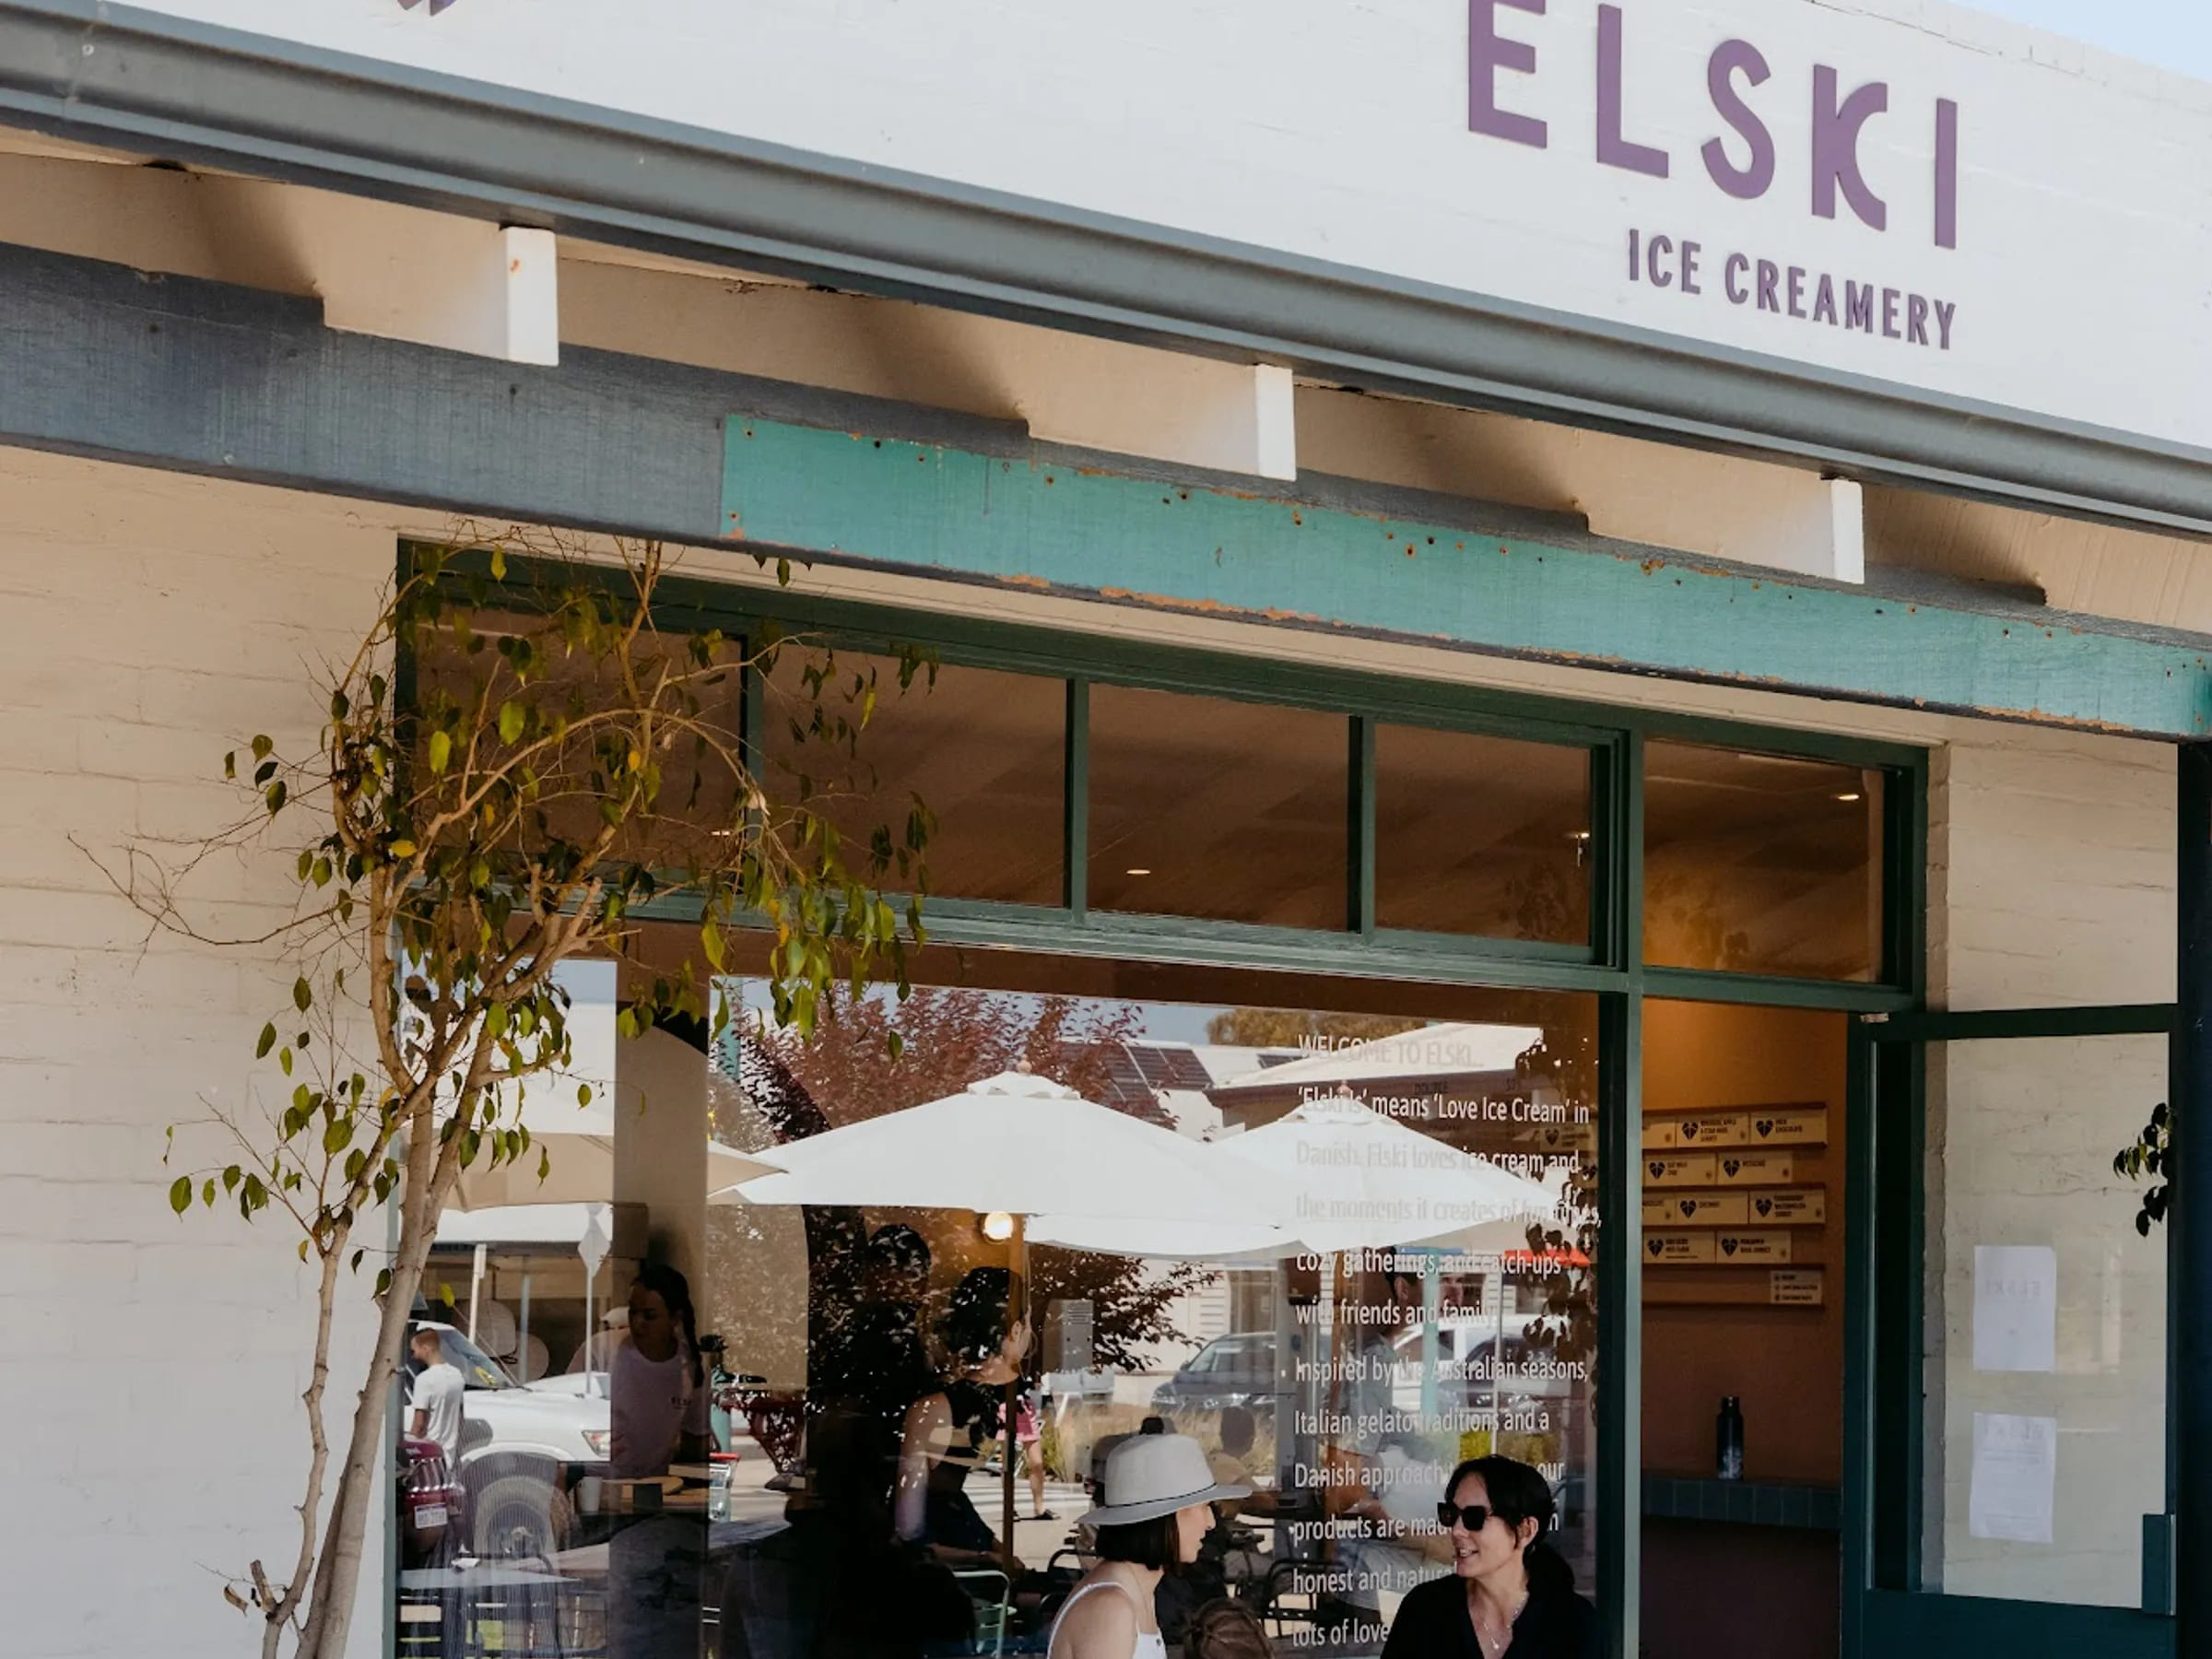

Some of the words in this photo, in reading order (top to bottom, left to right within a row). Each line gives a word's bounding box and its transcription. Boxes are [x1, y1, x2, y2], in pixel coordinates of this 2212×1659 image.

[1468, 0, 1958, 250] ELSKI
[1630, 228, 1701, 295] ICE
[1724, 252, 1956, 350] CREAMERY
[1297, 1032, 1391, 1064] WELCOME
[1398, 1041, 1421, 1065] TO
[1372, 1095, 1430, 1118] means
[1482, 1096, 1508, 1122] Ice
[1574, 1100, 1589, 1124] in
[1412, 1145, 1457, 1171] loves
[1492, 1152, 1545, 1174] cream
[1549, 1150, 1579, 1174] and
[1295, 1194, 1324, 1219] the
[1330, 1199, 1414, 1221] moments
[1433, 1199, 1500, 1222] creates
[1296, 1251, 1338, 1277] cozy
[1340, 1298, 1401, 1325] friends
[1406, 1299, 1437, 1325] and
[1295, 1355, 1367, 1387] Inspired
[1373, 1355, 1394, 1387] by
[1431, 1355, 1516, 1381] Australian
[1294, 1410, 1352, 1434] Italian
[1358, 1409, 1413, 1439] gelato
[1418, 1406, 1499, 1433] traditions
[1504, 1406, 1535, 1431] and
[1539, 1411, 1549, 1431] a
[1294, 1461, 1356, 1488] Danish
[1360, 1459, 1444, 1492] approach
[1293, 1512, 1372, 1547] products
[1376, 1517, 1406, 1538] are
[1293, 1568, 1354, 1594] honest
[1359, 1563, 1394, 1591] and
[1293, 1621, 1325, 1647] lots
[1330, 1618, 1349, 1644] of
